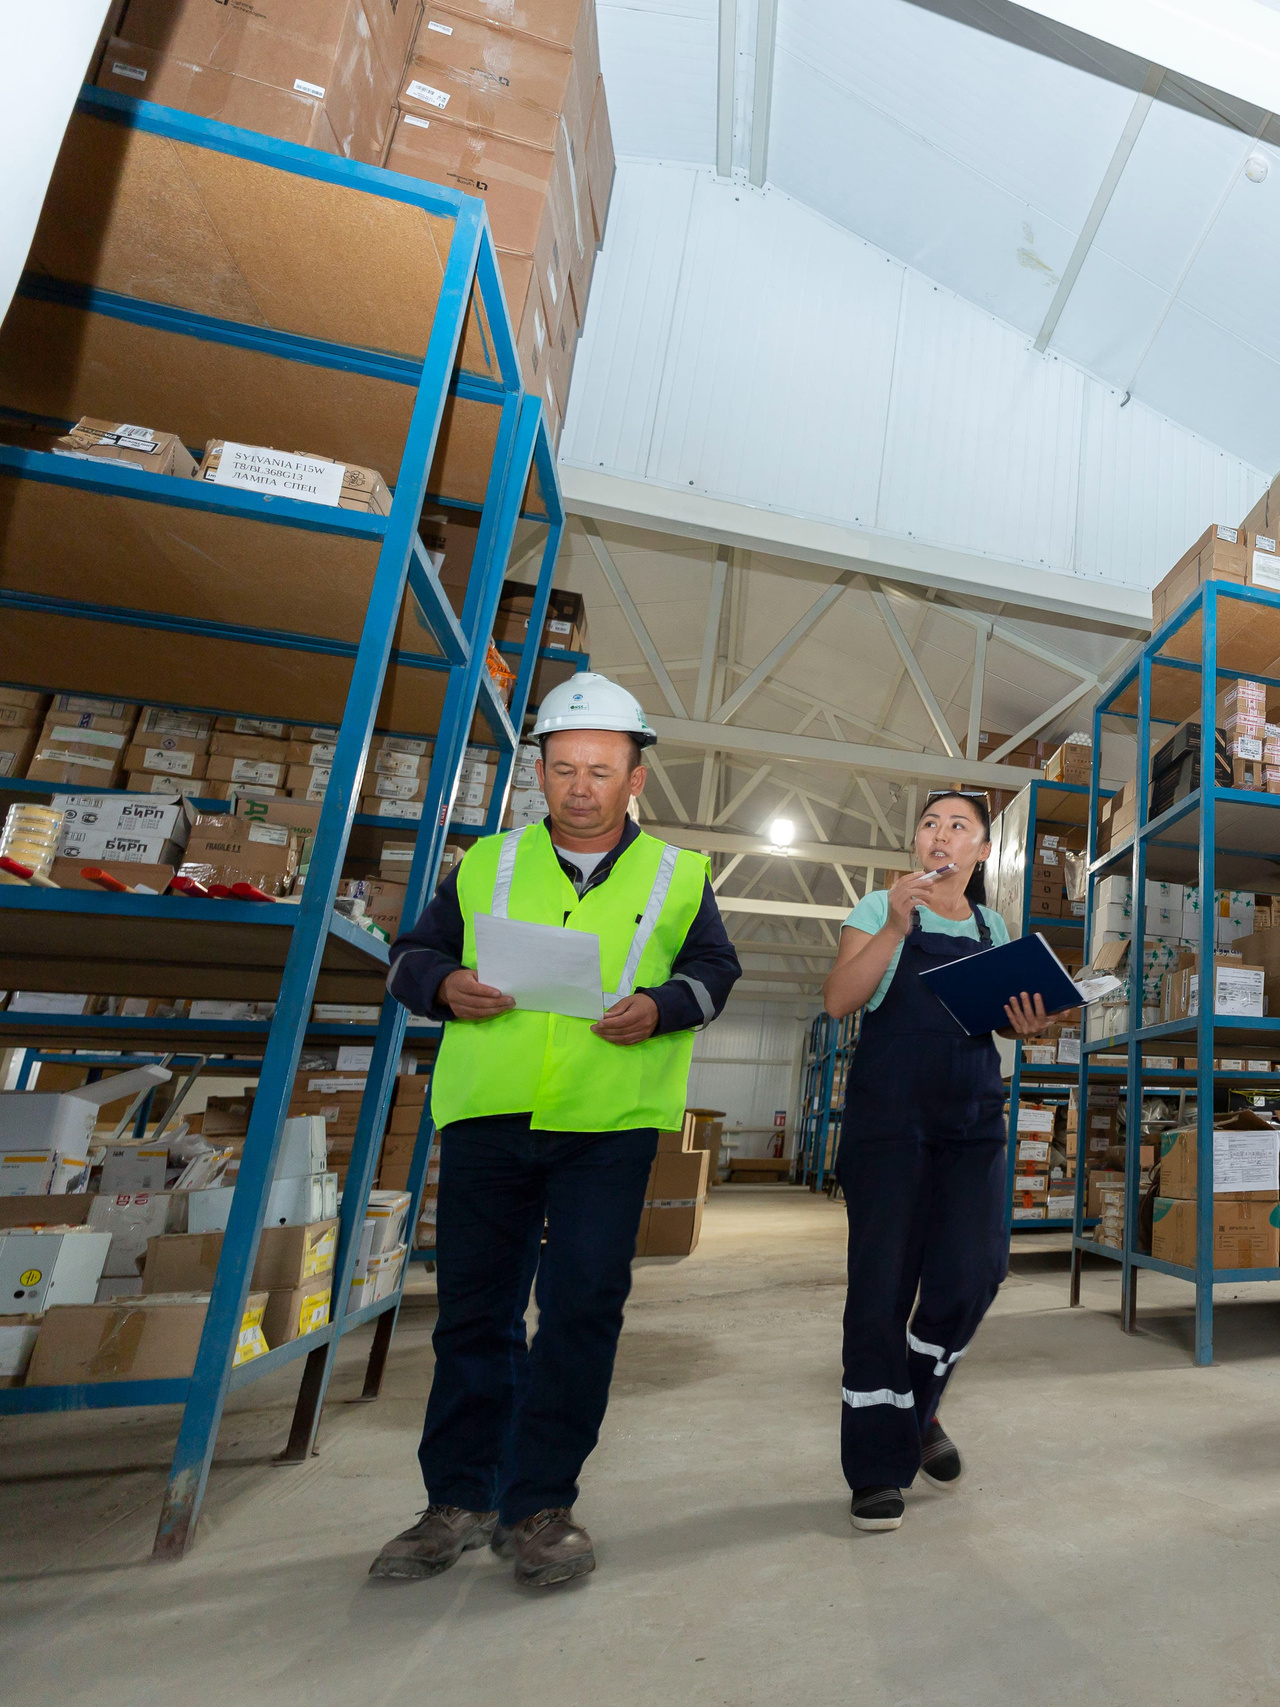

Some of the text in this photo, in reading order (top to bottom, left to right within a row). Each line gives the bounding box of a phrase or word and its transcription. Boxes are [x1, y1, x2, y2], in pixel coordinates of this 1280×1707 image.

[232, 461, 304, 481] T8/BL368G13
[234, 452, 326, 475] SYLVANIA F15W
[232, 472, 317, 494] ЛАМПА СПЕЦ
[121, 806, 165, 819] БИРП
[105, 840, 148, 853] БИРП
[205, 842, 231, 852] FRAGILE
